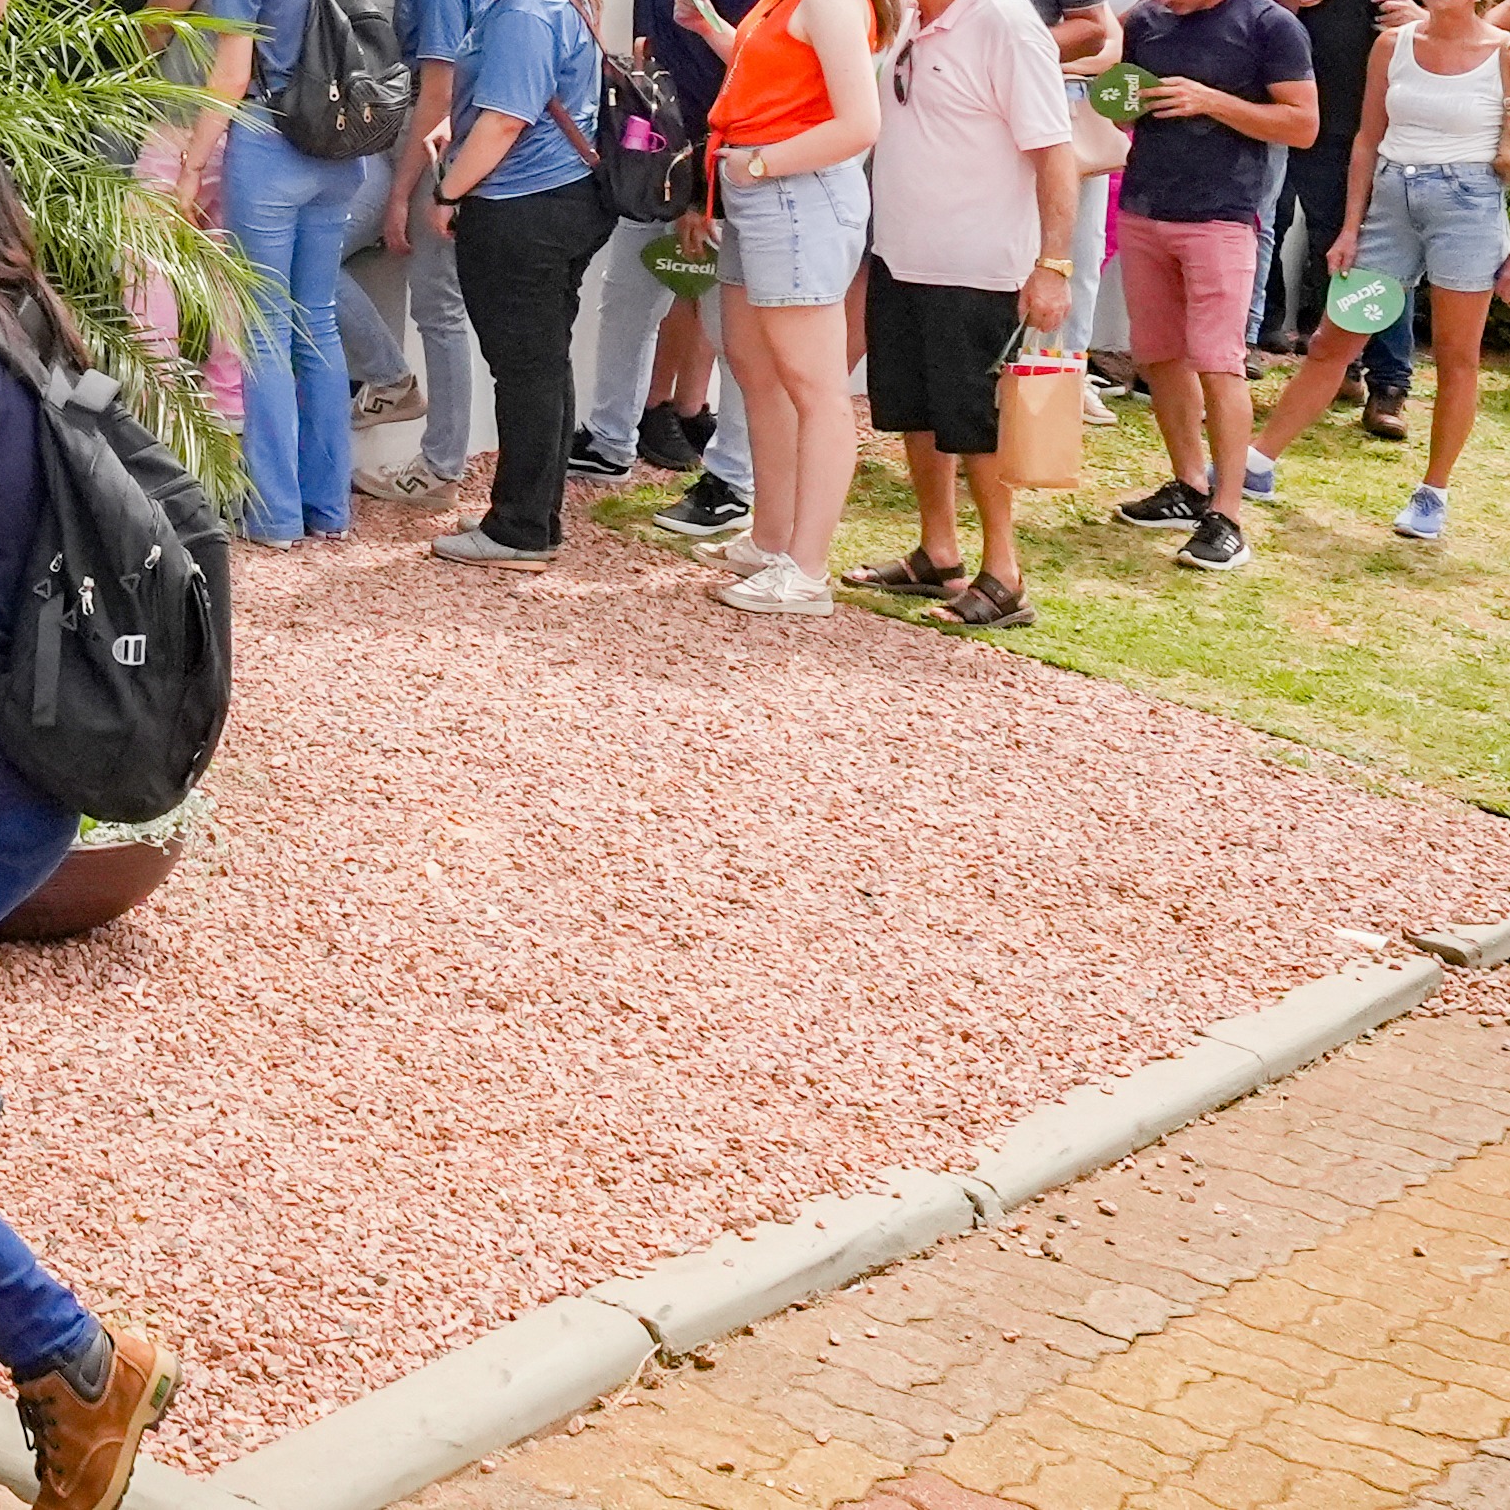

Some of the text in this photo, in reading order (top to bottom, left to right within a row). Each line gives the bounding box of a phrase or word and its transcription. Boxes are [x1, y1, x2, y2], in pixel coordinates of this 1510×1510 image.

[1123, 73, 1140, 112] Sicredi
[655, 257, 716, 275] Sicredi
[1336, 279, 1387, 313] Sicredi
